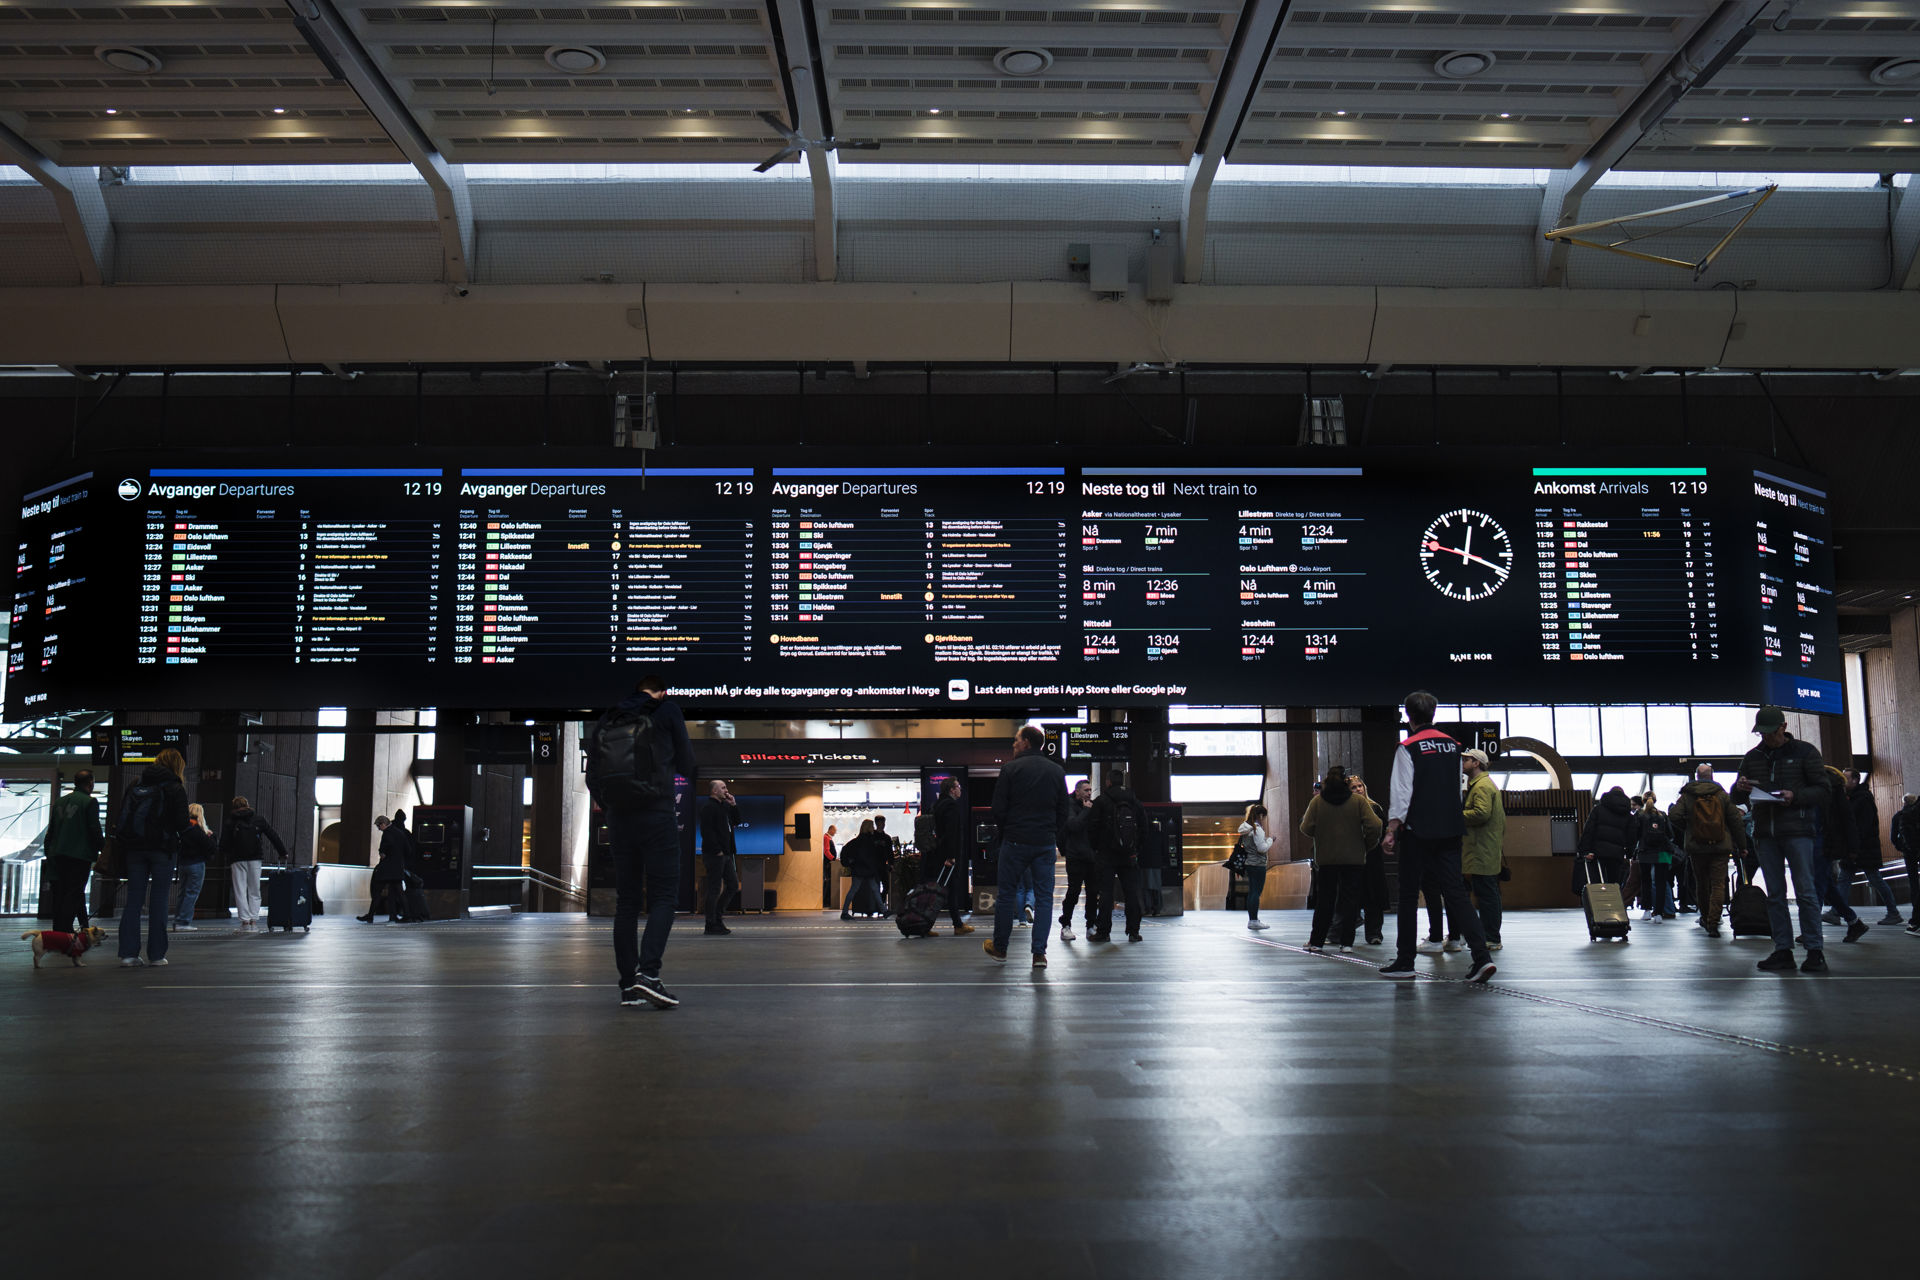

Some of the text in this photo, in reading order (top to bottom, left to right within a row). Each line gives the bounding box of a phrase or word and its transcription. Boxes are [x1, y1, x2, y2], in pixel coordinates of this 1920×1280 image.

[148, 483, 294, 499] Avganger Departures
[404, 482, 441, 495] 12 19
[460, 483, 605, 498] Avganger Departures
[715, 482, 753, 495] 12 19
[772, 482, 917, 497] Avganger Departures
[1027, 481, 1064, 494] 12 19
[1082, 482, 1257, 498] Neste tog til Next train to
[1534, 481, 1648, 494] Ankomst Arrivals
[1670, 482, 1707, 494] 12 19
[1754, 483, 1776, 499] Neste
[1777, 490, 1789, 506] tog
[1789, 494, 1797, 506] til
[22, 505, 40, 519] Neste
[41, 501, 51, 513] tog
[1083, 525, 1098, 536] Nå
[1145, 525, 1177, 536] 7 min
[1239, 525, 1271, 536] 4 min
[1302, 525, 1334, 536] 12:34
[1083, 580, 1115, 591] 8 min
[1147, 580, 1178, 591] 12:36
[1241, 579, 1257, 591] Nå
[1303, 580, 1335, 590] 4 min
[1581, 602, 1612, 610] Stavanger
[183, 615, 205, 623] Skøyen
[935, 635, 973, 643] Gjøvikbanen
[1084, 635, 1116, 646] 12:44
[1148, 635, 1180, 646] 13:04
[1243, 635, 1274, 646] 12:44
[1306, 634, 1337, 645] 13:14
[1765, 637, 1780, 650] 12:44
[1801, 643, 1815, 656] 12:44
[1450, 654, 1471, 662] BANE
[666, 686, 713, 697] eiseappen
[714, 684, 728, 695] NÅ
[730, 686, 743, 697] gir
[744, 686, 762, 697] deg
[763, 686, 780, 695] alle
[781, 687, 839, 697] togavganger
[840, 688, 853, 697] og
[854, 686, 906, 695] -ankomster
[912, 686, 940, 697] Norge
[975, 685, 994, 694] Last
[995, 685, 1013, 694] den
[1014, 685, 1032, 694] ned
[1033, 685, 1059, 696] gratis
[1065, 685, 1084, 696] App
[1086, 685, 1110, 694] Store
[1111, 685, 1131, 694] eller
[1133, 685, 1166, 696] Google
[1167, 684, 1187, 695] play
[1810, 690, 1820, 698] NOR
[99, 745, 108, 759] 7
[541, 744, 550, 758] 8
[1048, 743, 1056, 755] 9
[1418, 740, 1457, 753] ENTUR
[1481, 741, 1498, 755] 10
